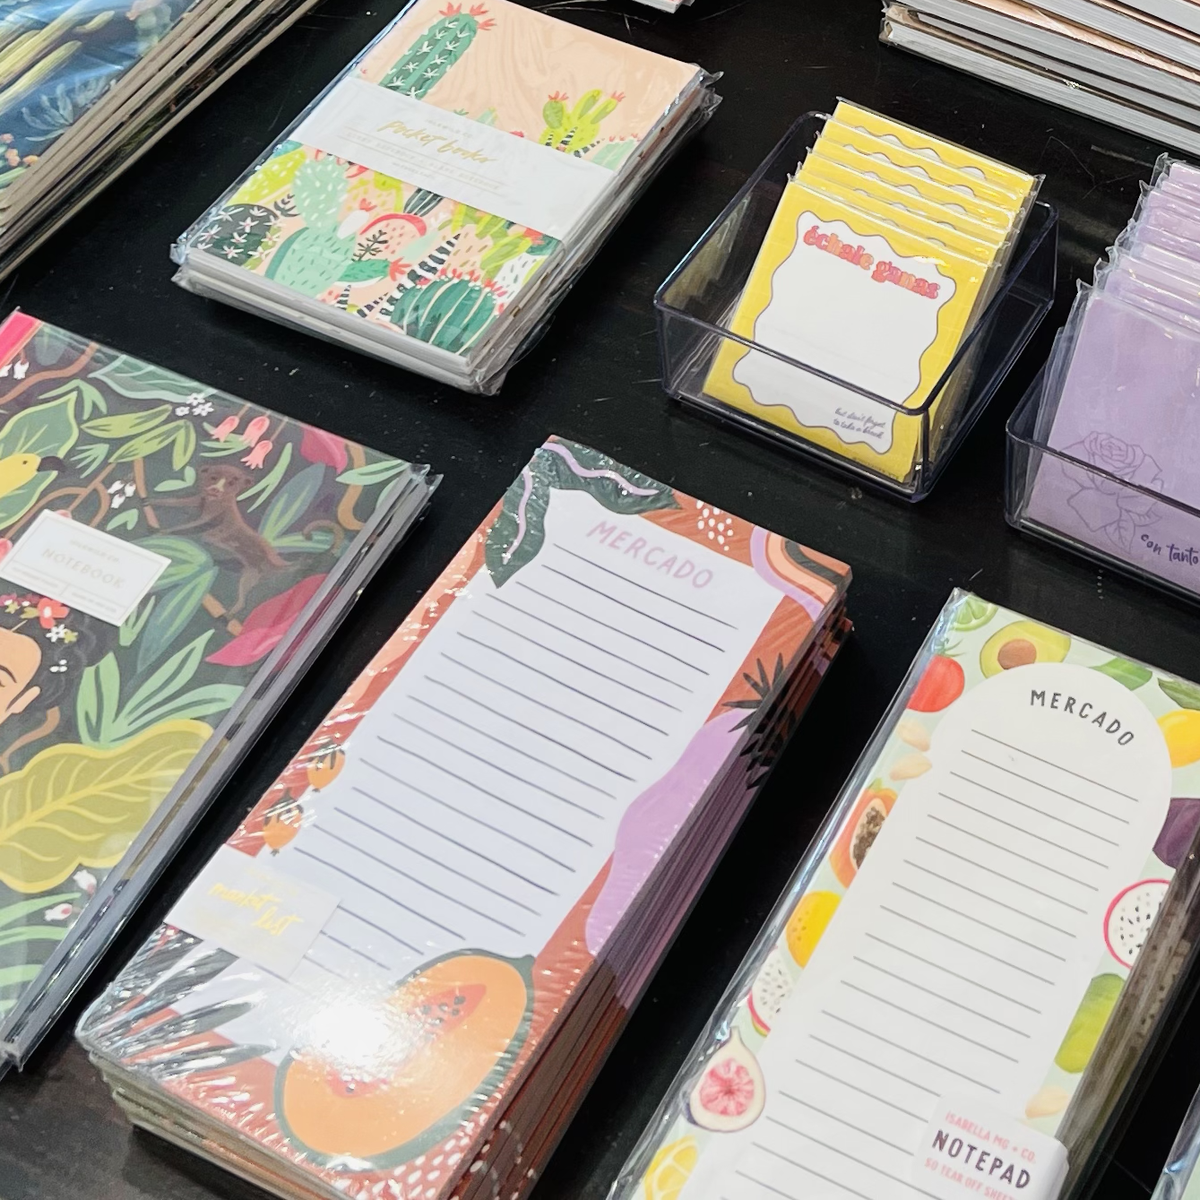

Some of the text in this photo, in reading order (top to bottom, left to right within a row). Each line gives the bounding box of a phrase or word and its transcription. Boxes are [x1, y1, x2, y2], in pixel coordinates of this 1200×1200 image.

[42, 549, 126, 589] NOTEBOOK
[585, 521, 714, 589] MERCADO
[1141, 533, 1162, 556] con
[1166, 543, 1200, 566] tanto
[1030, 689, 1135, 746] MERCADO
[945, 1111, 991, 1142] ISABELLA
[993, 1134, 1010, 1150] MG
[932, 1129, 1030, 1189] NOTEPAD
[940, 1165, 963, 1183] TEAR
[965, 1177, 982, 1192] OFF
